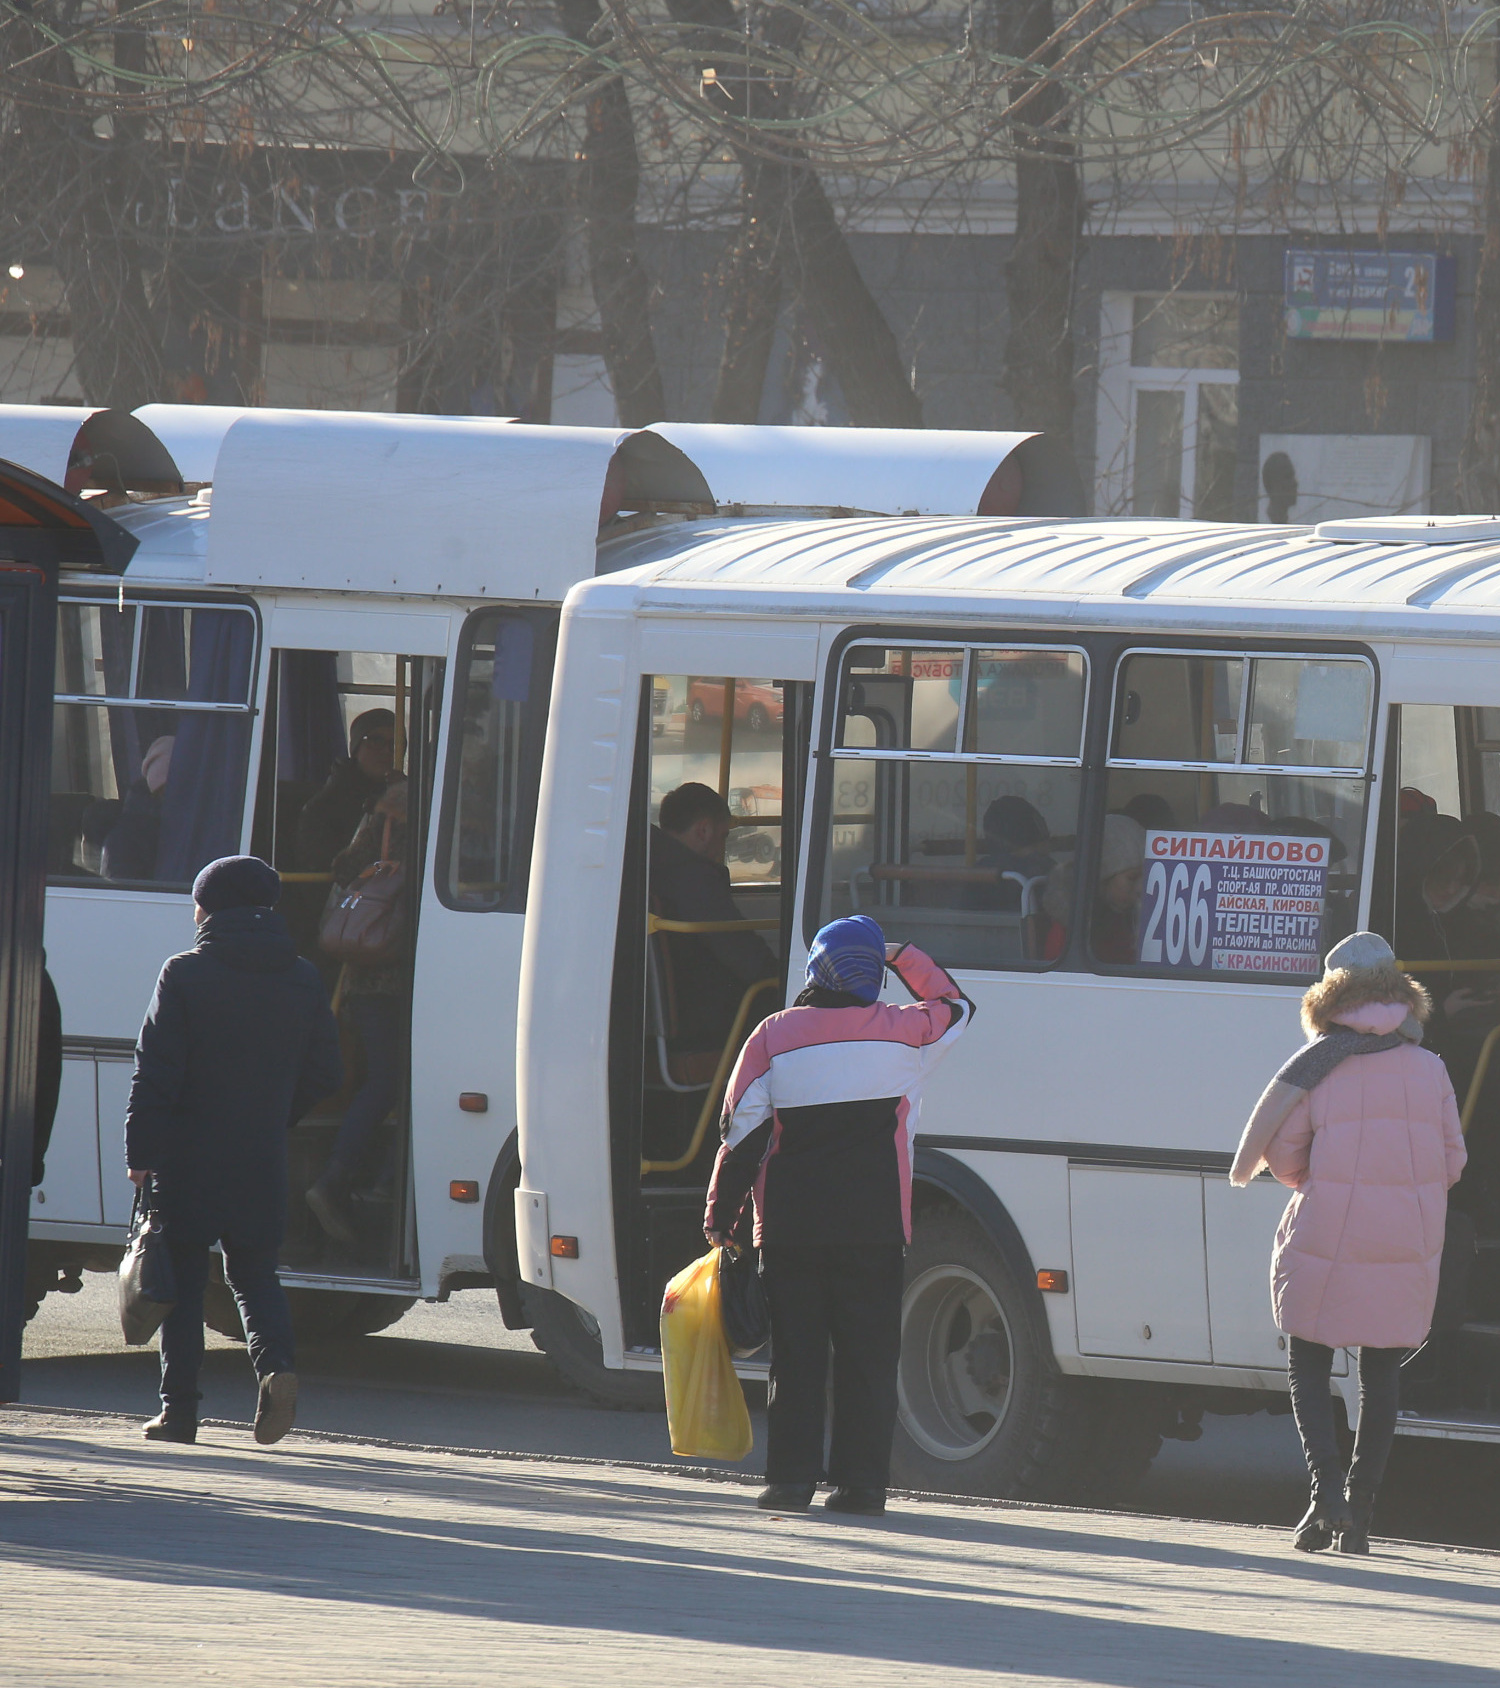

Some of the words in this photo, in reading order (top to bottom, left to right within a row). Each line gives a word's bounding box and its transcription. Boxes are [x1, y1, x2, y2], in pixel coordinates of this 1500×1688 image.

[1151, 836, 1324, 863] СИПАЙЛОВО
[1222, 866, 1240, 880] Т.Ц.
[1243, 866, 1321, 882] БАШКОРТОСТАН
[1217, 881, 1260, 895] СПОРТ-АЯ
[1265, 883, 1279, 896] ПР.
[1281, 884, 1322, 897] ОКТЯБРЯ
[1218, 895, 1269, 913] АЙСКАЯ,
[1272, 899, 1320, 913] КИРОВА
[1140, 861, 1212, 967] 266
[1215, 912, 1319, 938] ТЕЛЕЦЕНТР
[1212, 937, 1222, 947] по
[1224, 935, 1260, 949] ГАФУРИ
[1262, 940, 1273, 950] до
[1275, 938, 1316, 952] КРАСИНА
[1227, 954, 1318, 973] КРАСИНСКИЙ
